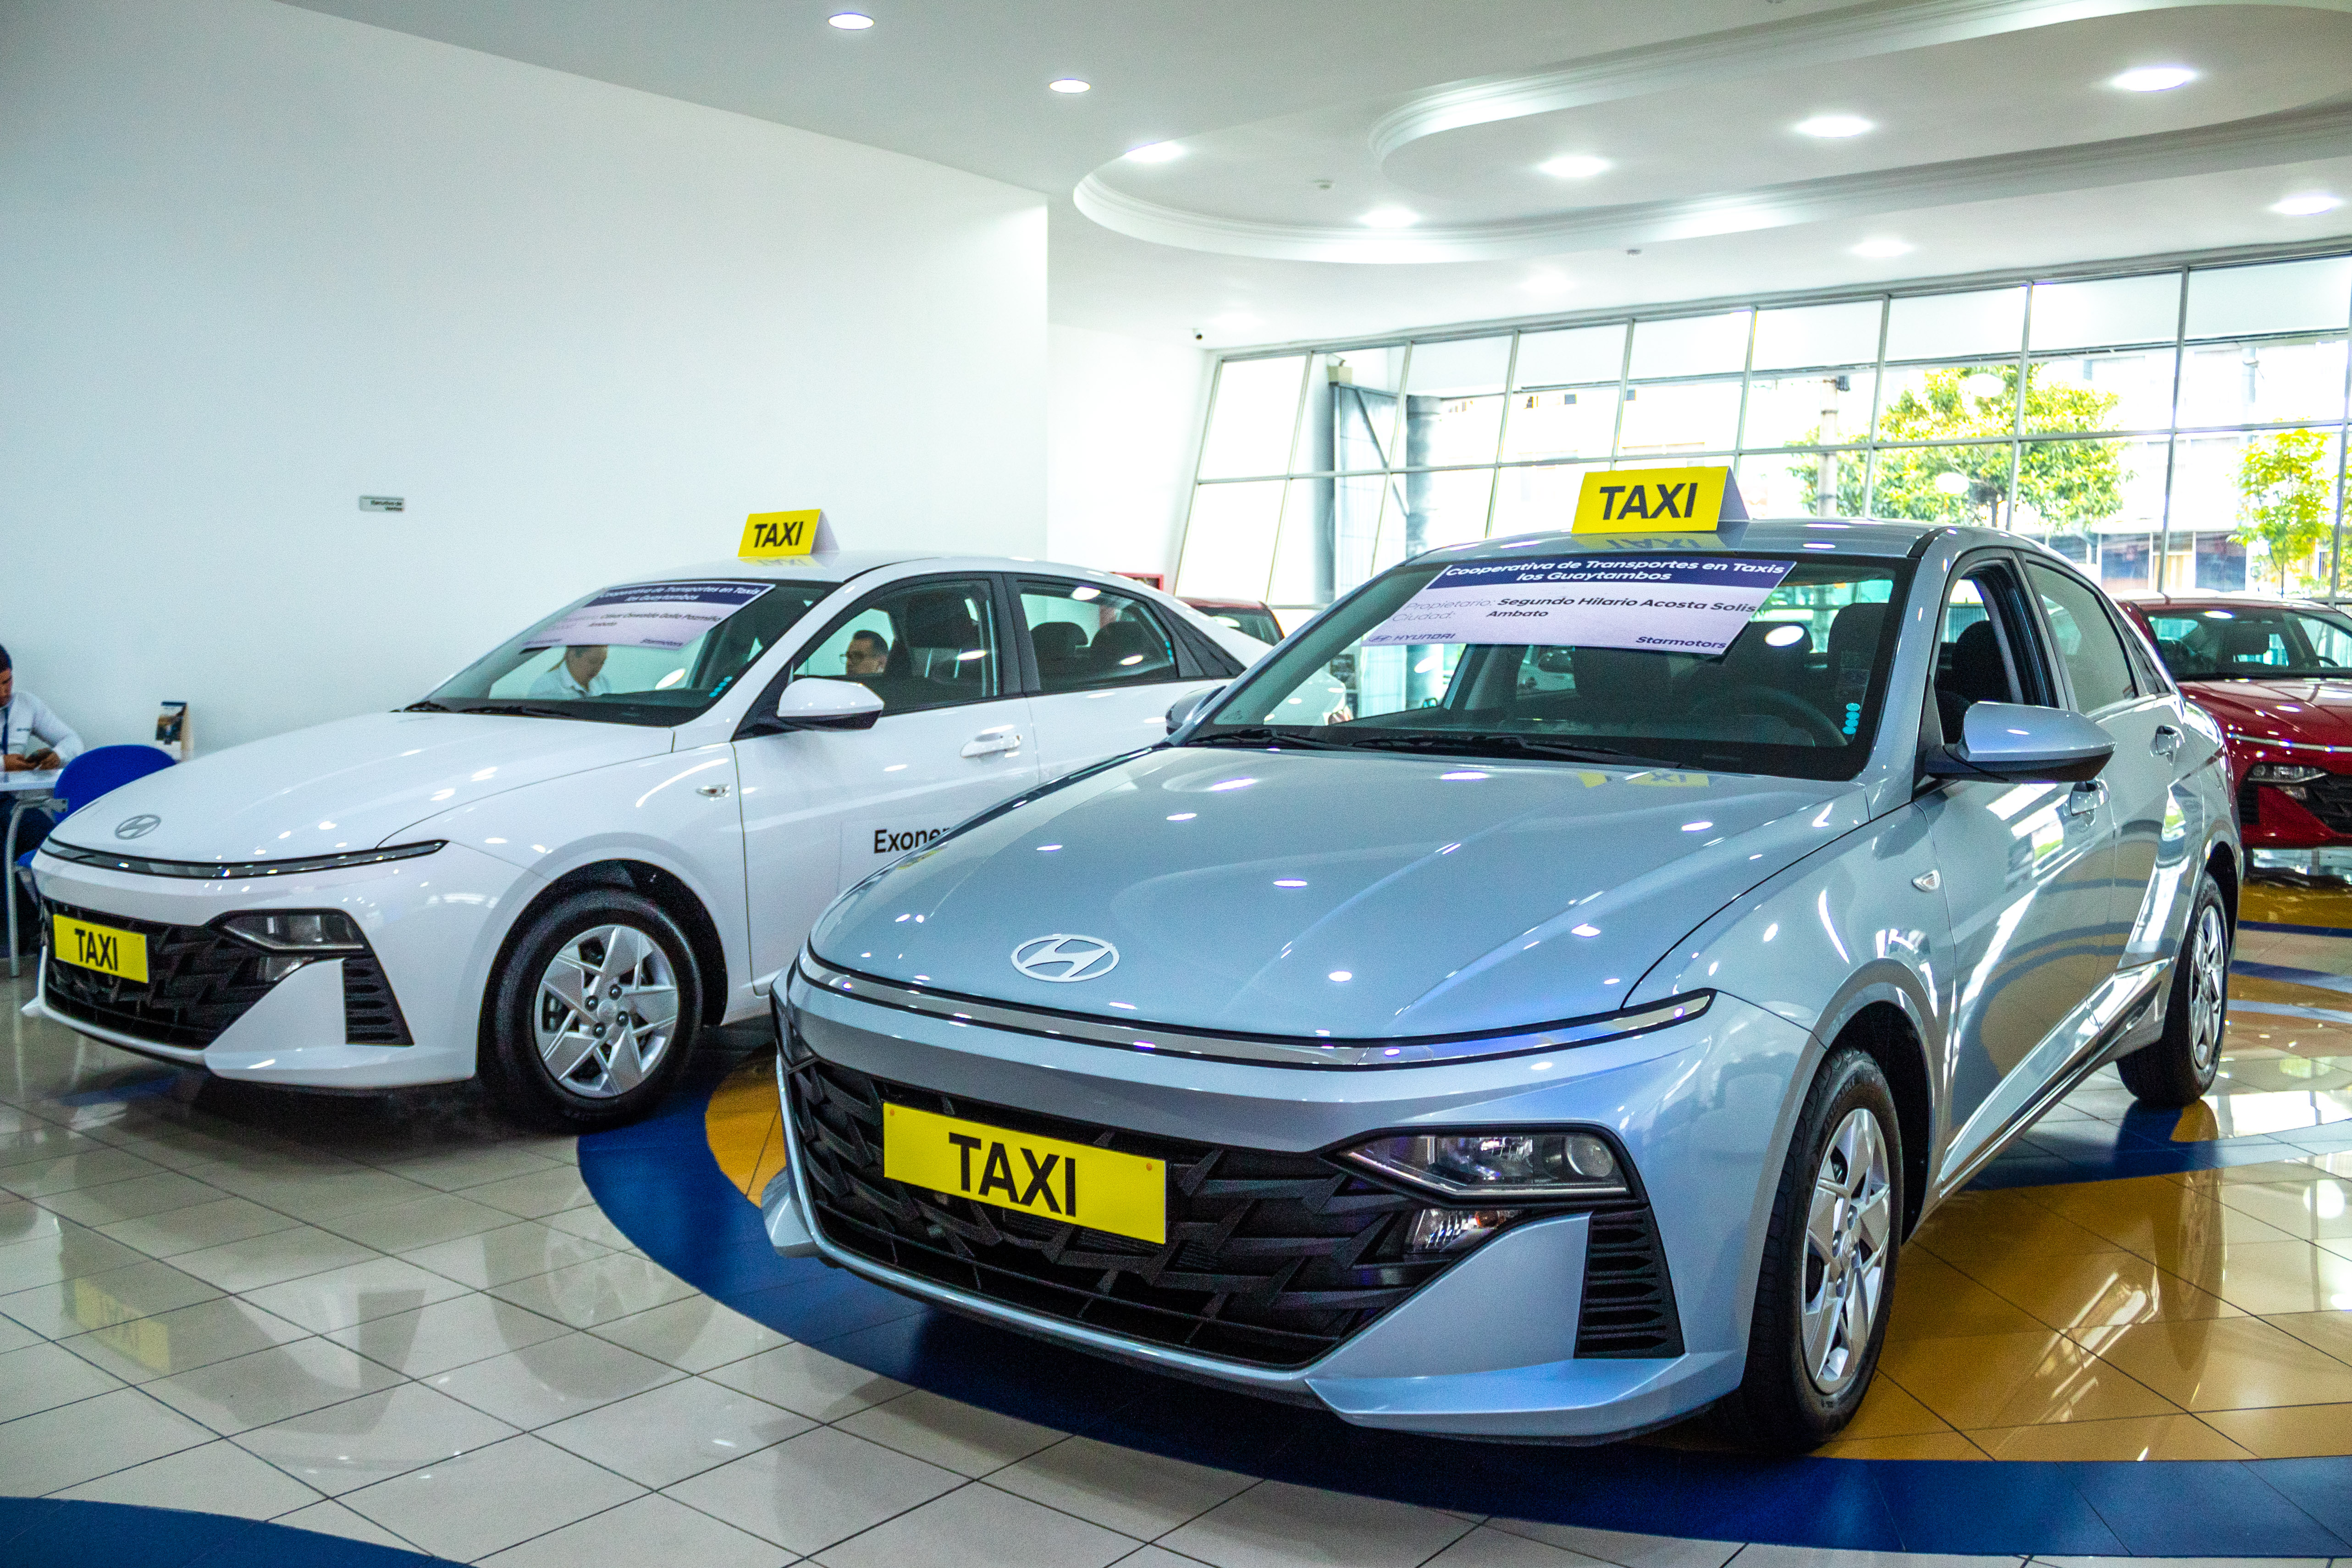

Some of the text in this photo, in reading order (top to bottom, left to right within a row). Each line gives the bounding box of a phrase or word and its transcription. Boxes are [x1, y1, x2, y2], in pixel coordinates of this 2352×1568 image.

[1600, 483, 1698, 520] TAXI
[754, 521, 804, 548] TAXI
[1446, 562, 1556, 576] Cooperativa
[1557, 561, 1582, 569] de
[1586, 560, 1699, 570] Transportes
[1733, 563, 1785, 574] Taxis
[1516, 571, 1673, 581] los Guaytambos
[1404, 599, 1496, 611] Propietario:
[1497, 597, 1575, 606] Segundo
[1578, 597, 1638, 606] Hilario
[1640, 599, 1708, 609] Acosta
[1393, 633, 1456, 641] HYUNDAI
[1635, 636, 1727, 649] Starmotors
[874, 828, 950, 854] Exone
[74, 928, 118, 972] TAXI
[949, 1132, 1077, 1218] TAXI
